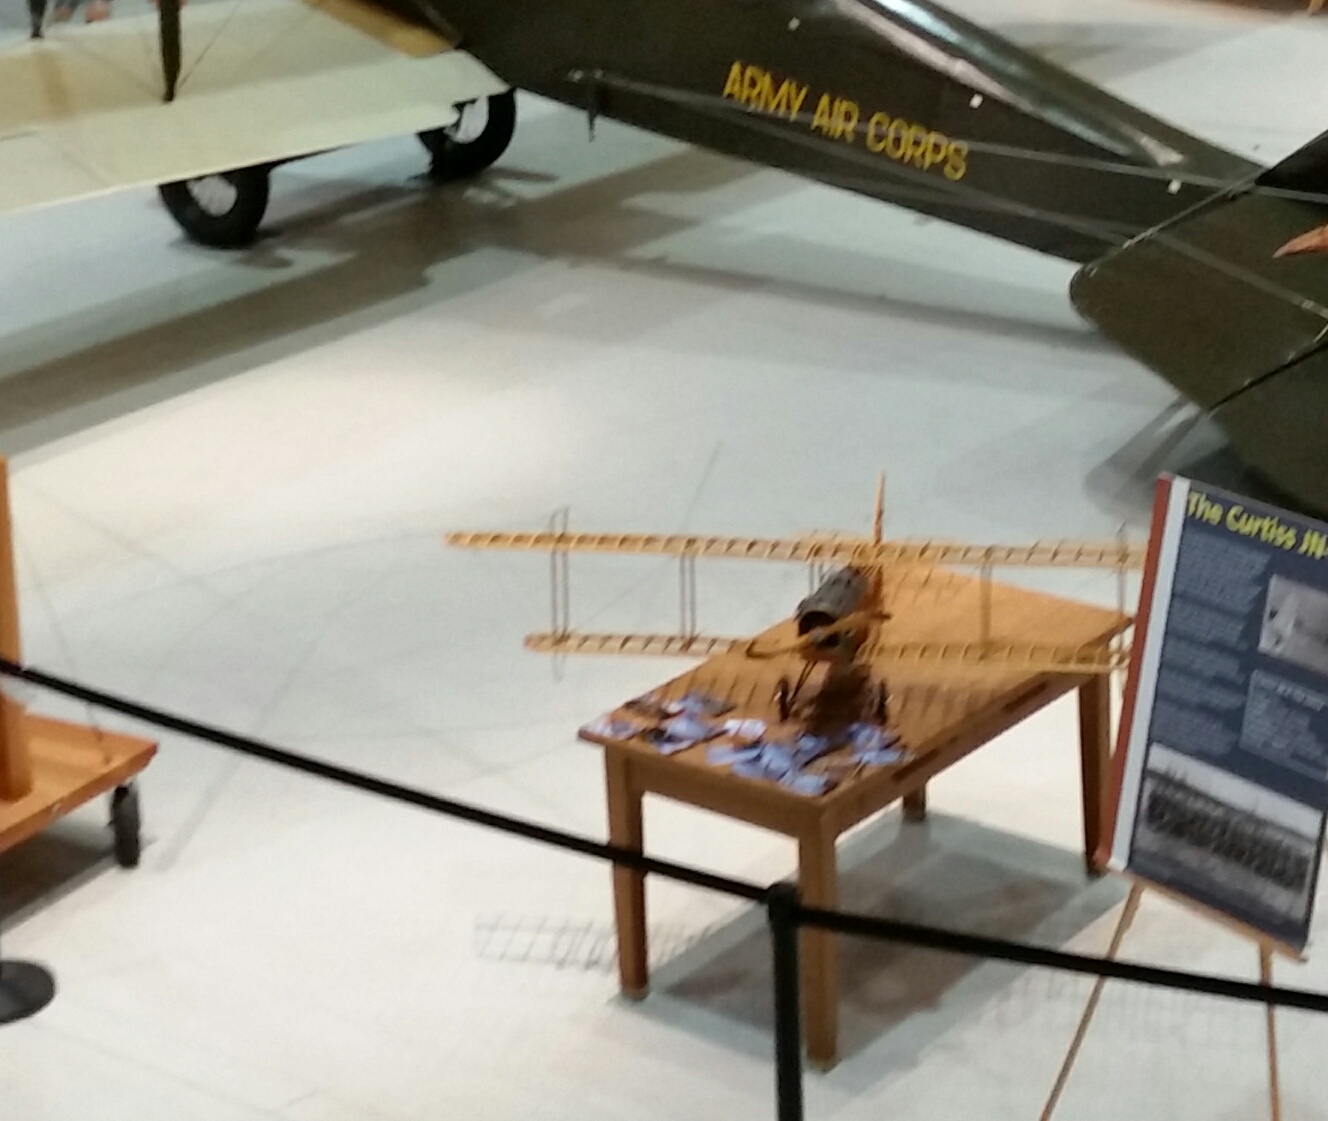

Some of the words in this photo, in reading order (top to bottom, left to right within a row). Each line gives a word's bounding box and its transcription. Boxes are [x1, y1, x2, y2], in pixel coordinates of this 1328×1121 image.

[723, 61, 809, 121] ARMY
[811, 93, 860, 143] AIR
[865, 111, 969, 181] CORPS
[1187, 491, 1224, 526] The
[1226, 504, 1296, 550] Curtiss
